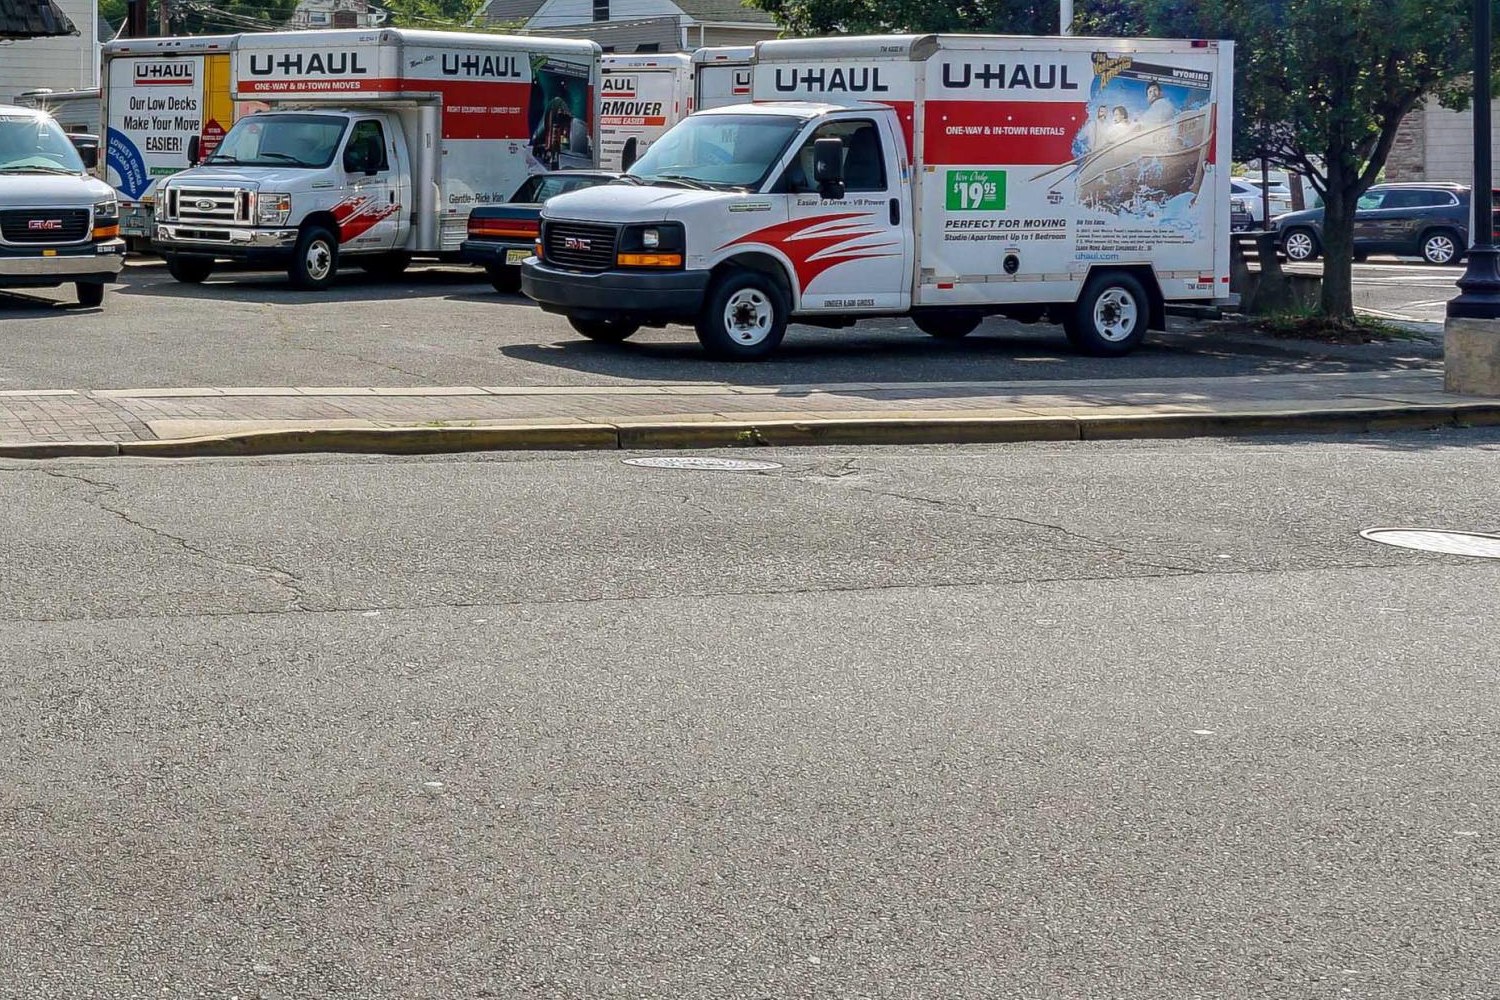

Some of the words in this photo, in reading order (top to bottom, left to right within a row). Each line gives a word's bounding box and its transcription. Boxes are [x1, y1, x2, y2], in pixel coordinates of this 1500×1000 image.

[137, 64, 192, 77] U-HAUL
[250, 52, 367, 75] U-HAUL
[442, 54, 521, 77] U-HAUL
[775, 67, 888, 92] U-HAUL
[943, 63, 1078, 90] U-HAUL
[1173, 69, 1209, 81] WYOMING
[332, 81, 360, 89] MOVES
[602, 78, 635, 90] AUL
[129, 96, 145, 110] Our
[147, 97, 165, 110] Low
[168, 96, 196, 110] Decks
[601, 101, 662, 116] RMOVER
[124, 116, 148, 130] Make
[152, 116, 172, 130] Your
[174, 117, 199, 130] Move
[946, 126, 983, 135] ONE-WAY
[984, 127, 991, 135] &
[993, 127, 1028, 135] IN-TOWN
[1029, 127, 1066, 136] RENTALS
[110, 137, 132, 159] LOWEST
[146, 137, 182, 151] EASIER!
[492, 192, 504, 203] Van
[29, 220, 62, 229] GMC
[945, 220, 994, 228] PERFECT
[998, 220, 1020, 228] FOR
[1023, 219, 1066, 228] MOVING
[565, 237, 591, 251] GMC
[1010, 233, 1020, 241] Up
